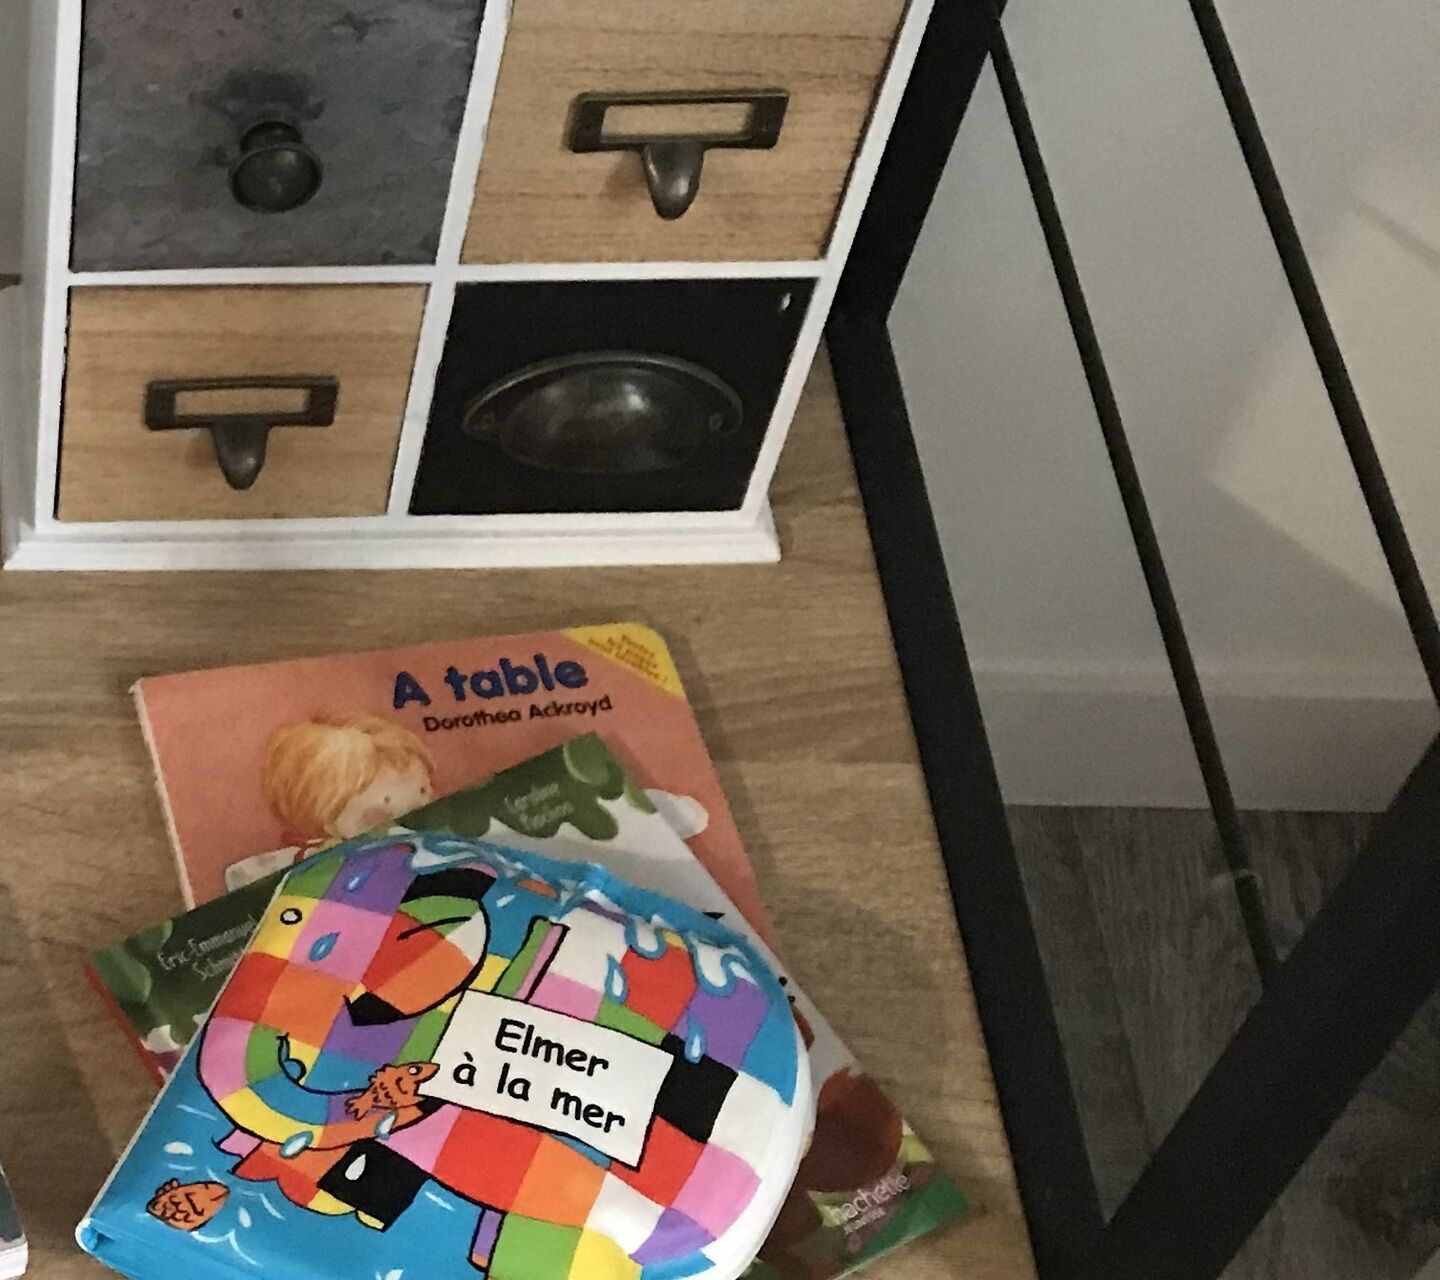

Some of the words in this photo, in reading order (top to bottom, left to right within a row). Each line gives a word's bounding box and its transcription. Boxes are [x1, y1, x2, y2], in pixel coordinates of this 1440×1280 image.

[393, 671, 431, 709] A
[444, 653, 588, 701] table
[423, 708, 521, 732] Dorothea
[529, 694, 613, 719] Ackroyd
[495, 1018, 608, 1076] Elmer
[453, 1051, 476, 1086] à
[497, 1063, 531, 1101] la
[551, 1087, 625, 1133] mer
